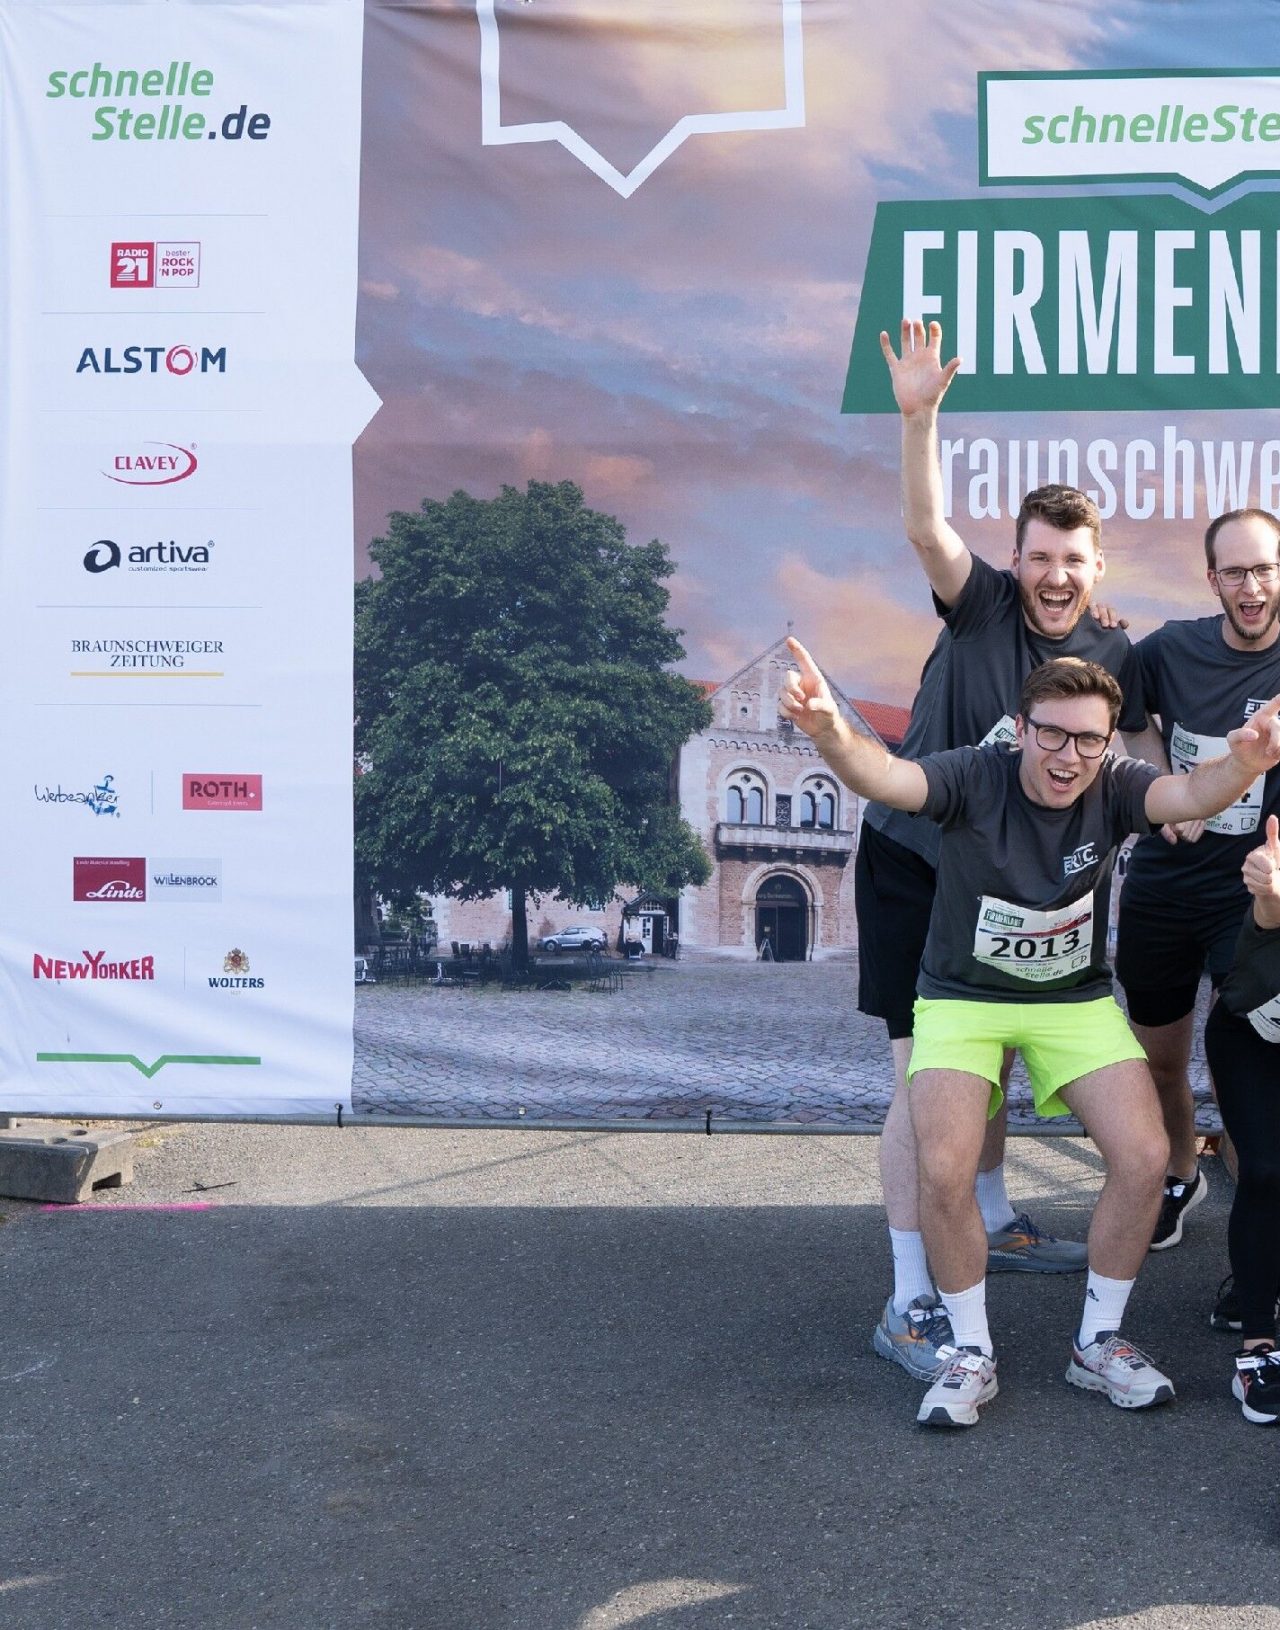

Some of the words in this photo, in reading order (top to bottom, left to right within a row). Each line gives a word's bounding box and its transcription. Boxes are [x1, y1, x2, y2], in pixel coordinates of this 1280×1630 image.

[46, 62, 214, 98] schnelle
[92, 105, 271, 140] Stelle.de
[117, 249, 149, 257] RADIO
[116, 257, 148, 281] 21
[162, 258, 194, 266] ROCK
[172, 268, 194, 276] POP
[76, 344, 226, 376] ALSTOM
[114, 455, 179, 471] CLAVEY
[72, 640, 224, 653] BRAUNSCHWEIGER
[110, 655, 184, 667] ZEITUNG
[86, 880, 144, 899] Linde
[990, 929, 1081, 959] 2013
[208, 977, 265, 988] WOLTERS
